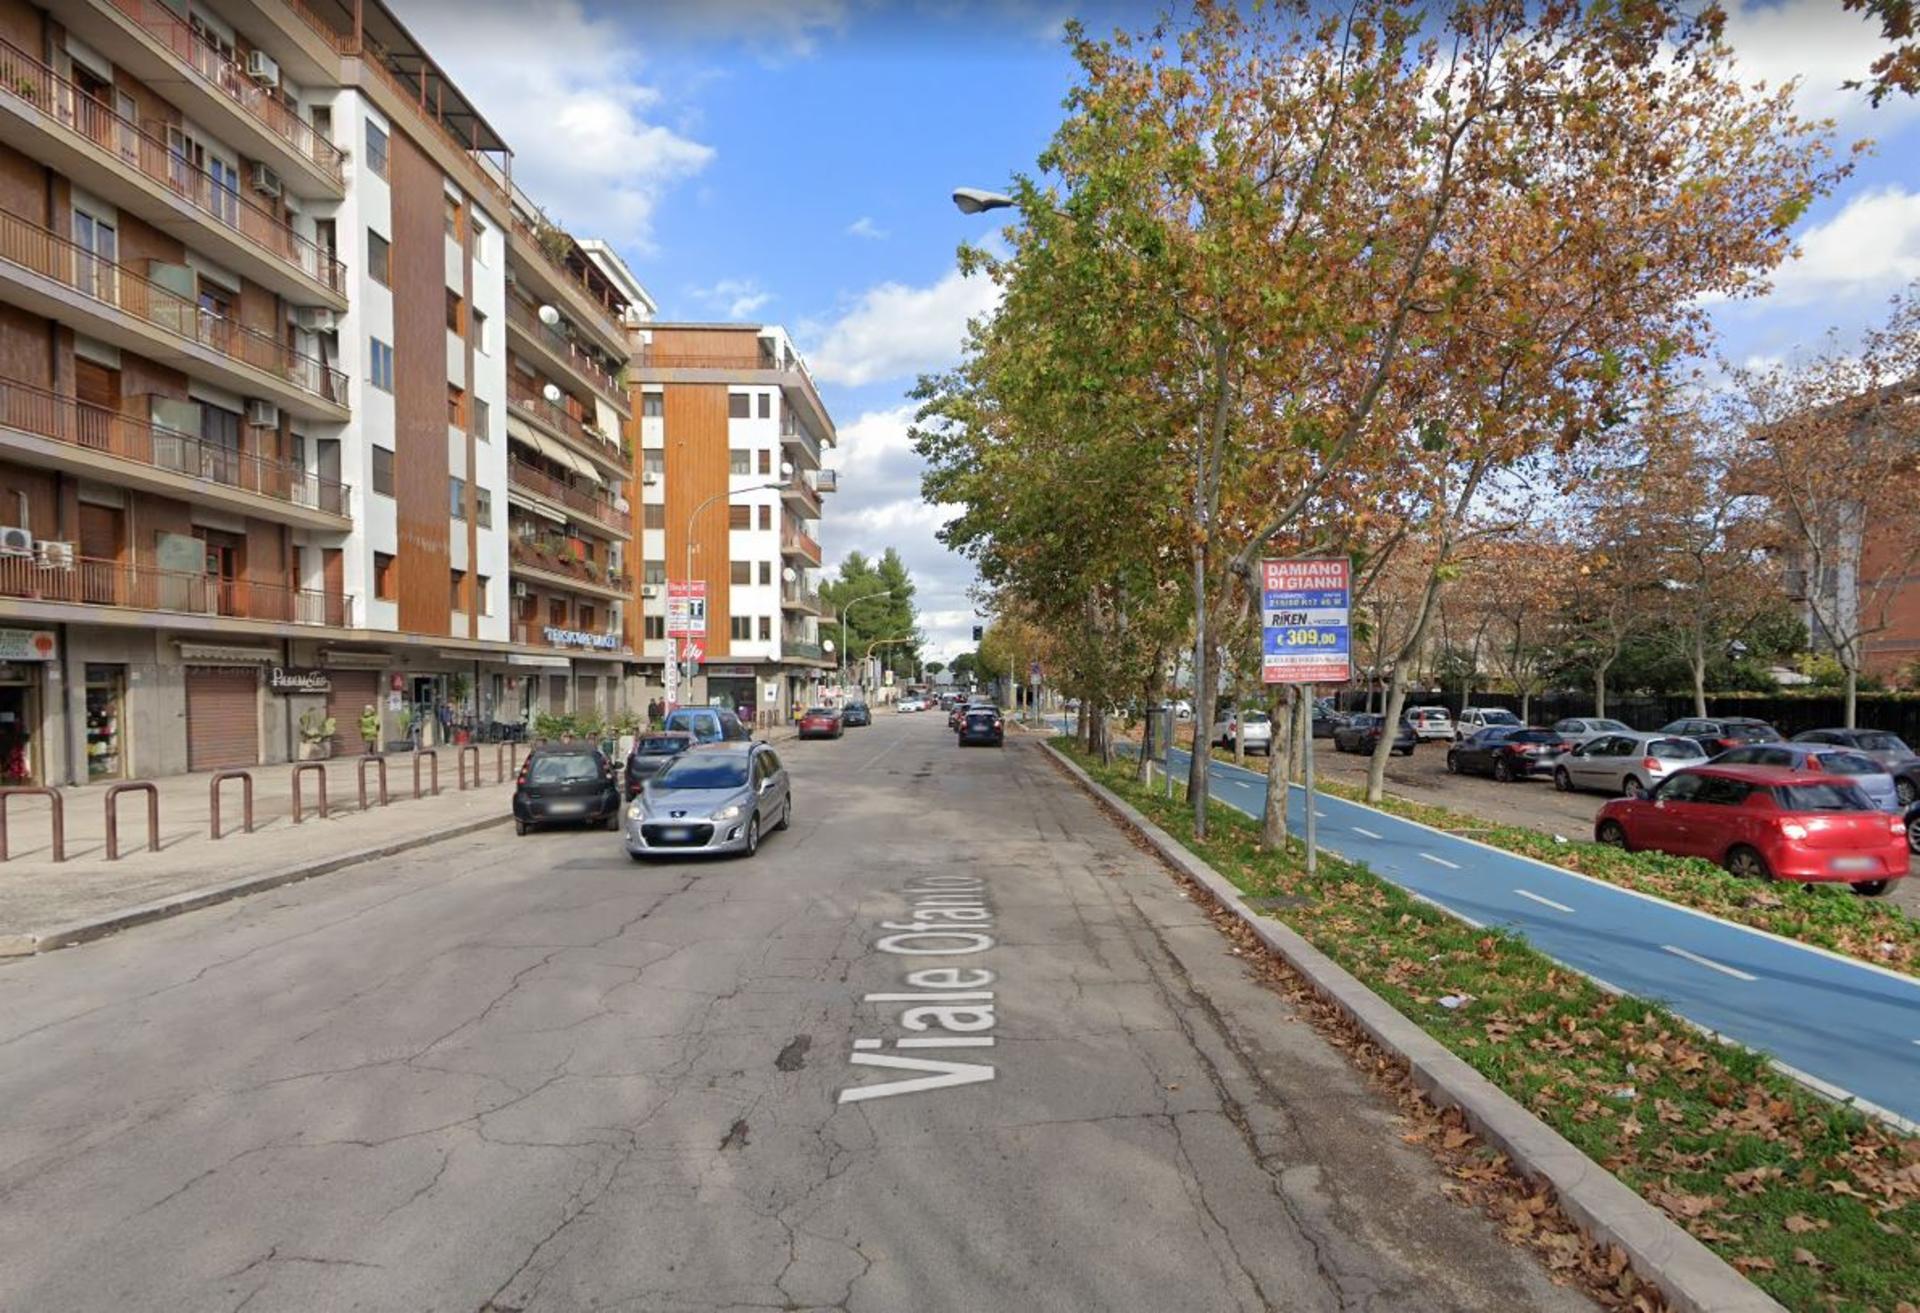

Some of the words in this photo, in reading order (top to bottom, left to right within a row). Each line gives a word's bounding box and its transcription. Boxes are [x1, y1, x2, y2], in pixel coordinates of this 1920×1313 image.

[1268, 563, 1341, 576] DAMIANO
[1268, 578, 1283, 589] DI
[1288, 577, 1342, 589] GIANNI
[1287, 630, 1336, 646] 309,00
